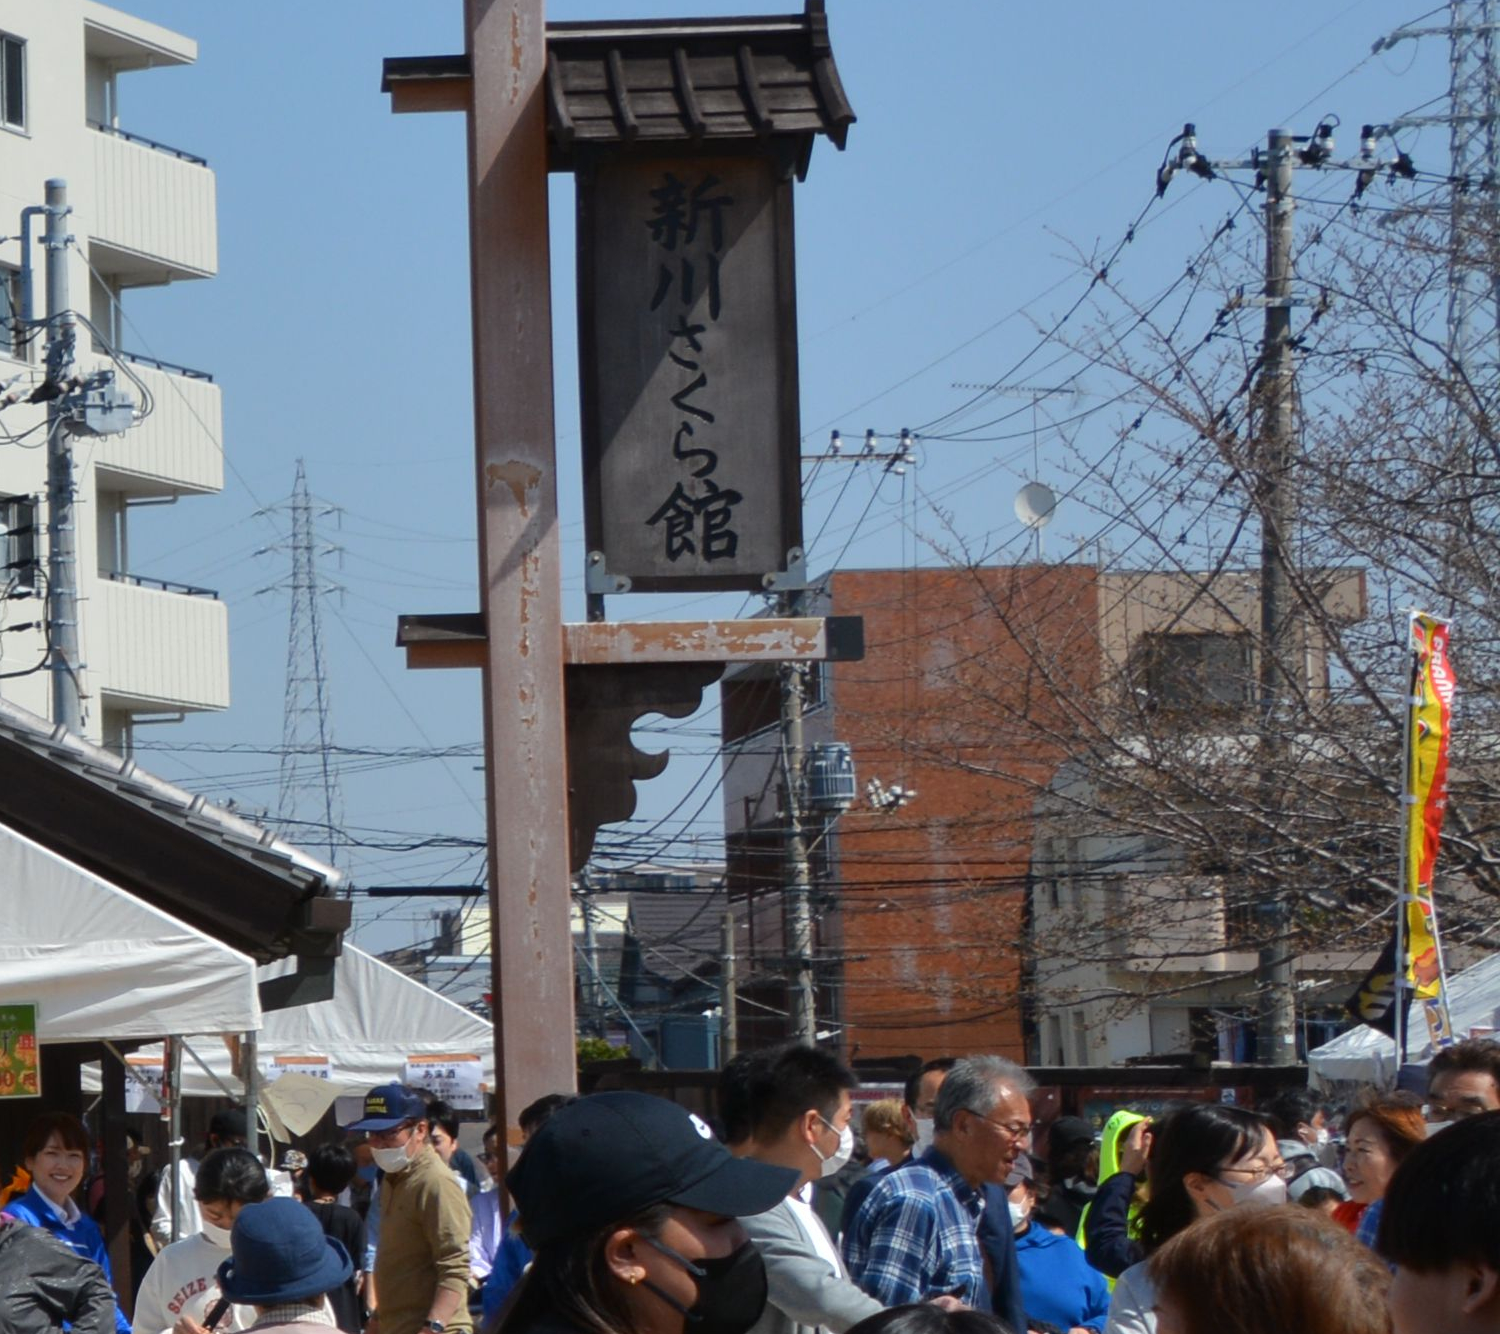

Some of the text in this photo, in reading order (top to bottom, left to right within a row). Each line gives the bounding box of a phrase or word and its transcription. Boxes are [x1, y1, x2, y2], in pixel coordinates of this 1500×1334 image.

[645, 172, 743, 562] 新川さくら館
[167, 1277, 208, 1315] SEIZE
